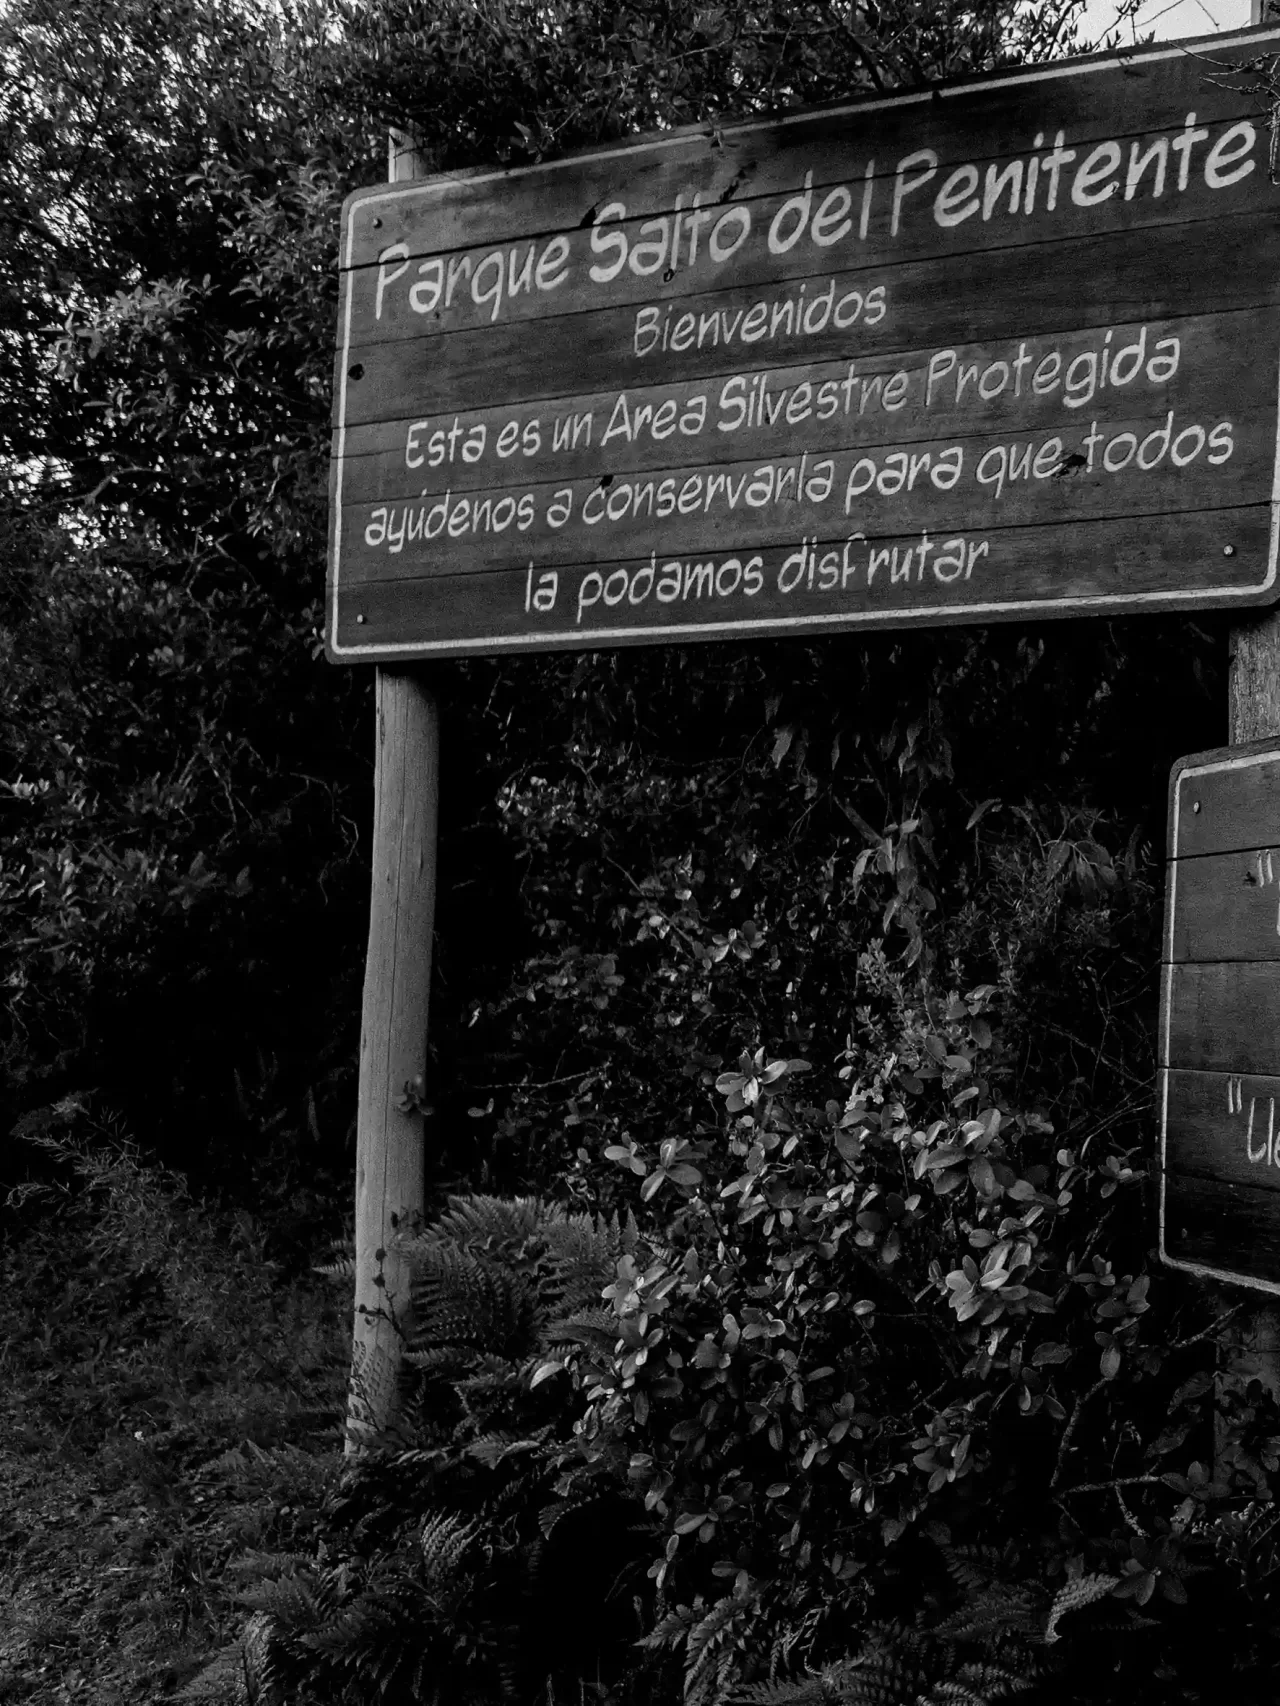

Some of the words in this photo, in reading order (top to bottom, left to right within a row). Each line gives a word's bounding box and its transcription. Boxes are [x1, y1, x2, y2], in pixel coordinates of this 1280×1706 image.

[374, 241, 571, 321] Parque
[588, 191, 752, 284] Salto
[767, 168, 876, 256] del
[890, 111, 1258, 238] Penitente
[633, 278, 887, 358] Bienvenidos
[405, 416, 487, 469] Esta
[496, 418, 542, 459] es
[552, 412, 592, 454] un
[600, 393, 708, 447] Area
[717, 373, 909, 433] Silvestre
[925, 325, 1181, 409] Protegida
[546, 488, 573, 528] a
[582, 449, 835, 525] conservarla
[845, 444, 965, 515] para
[976, 435, 1064, 499] que
[1081, 409, 1236, 474] todos
[524, 561, 559, 613] la
[576, 550, 764, 624] podamos
